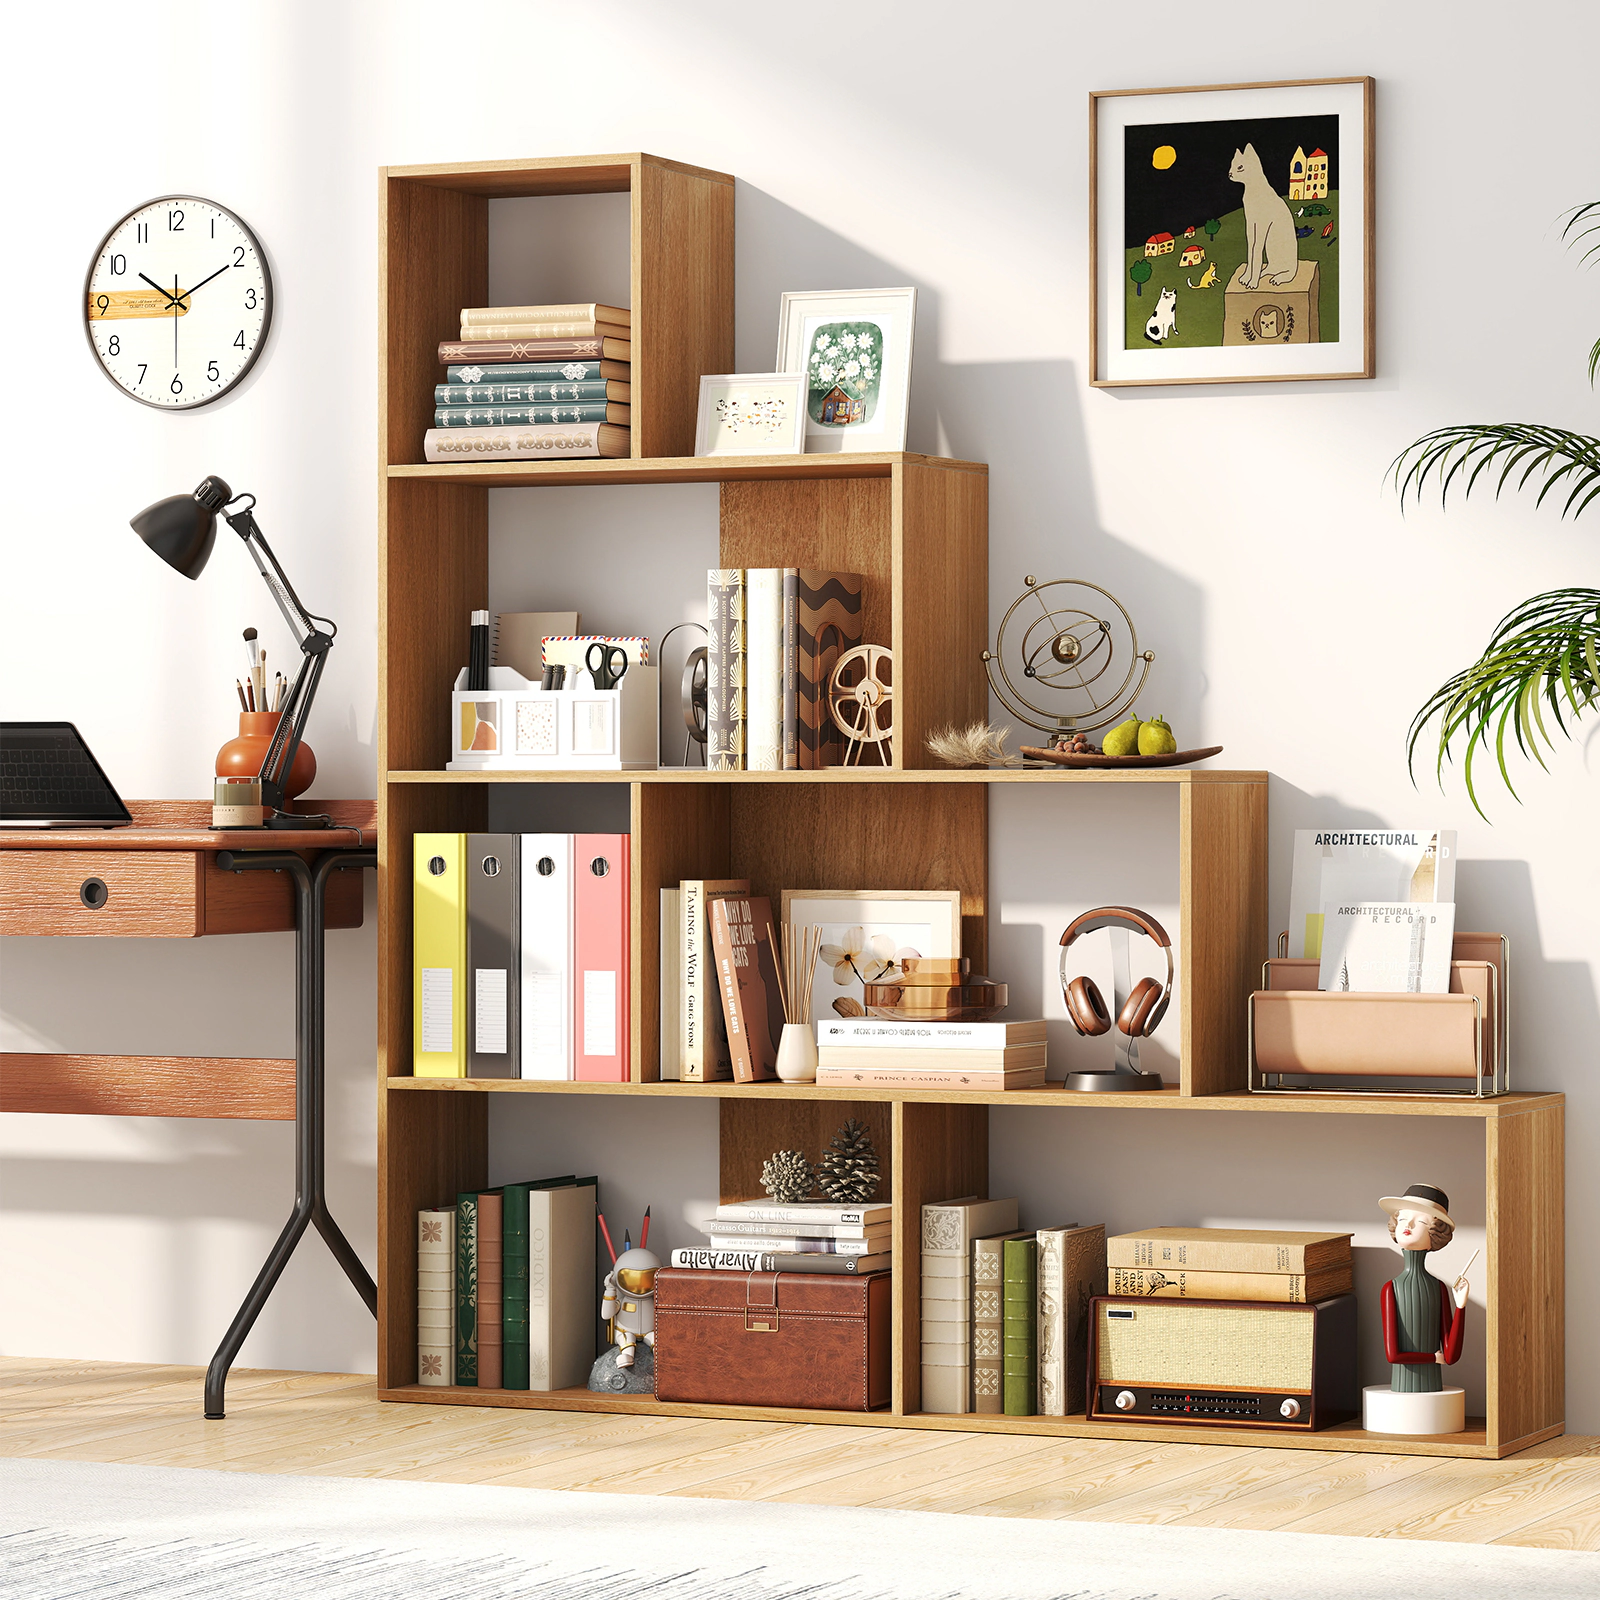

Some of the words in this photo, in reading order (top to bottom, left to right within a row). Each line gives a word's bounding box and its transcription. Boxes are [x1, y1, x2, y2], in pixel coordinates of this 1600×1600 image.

[169, 210, 185, 231] 12
[137, 222, 148, 243] 11
[110, 254, 126, 275] 10
[233, 246, 245, 267] 2
[96, 294, 110, 316] 9
[245, 288, 257, 310] 3
[468, 312, 516, 320] LATINARUM
[515, 311, 545, 319] VOCUM
[108, 335, 120, 356] 8
[233, 329, 246, 350] 4
[137, 363, 148, 384] 7
[206, 360, 220, 382] 5
[170, 373, 183, 394] 6
[1315, 833, 1419, 846] ARCHITECTURAL
[687, 886, 697, 935] TAMING
[723, 900, 742, 924] WHY
[740, 900, 752, 923] DO
[1338, 906, 1414, 916] ARCHITECTURAL
[1372, 915, 1437, 924] RECORD
[687, 938, 695, 952] the
[739, 924, 756, 945] LOVE
[721, 958, 730, 975] WHY
[732, 946, 749, 968] CATS
[687, 953, 697, 988] WOLF
[724, 975, 732, 986] DO
[726, 986, 734, 998] WE
[688, 995, 696, 1020] GREG
[728, 998, 737, 1015] LOVE
[687, 1021, 696, 1049] STONE
[731, 1016, 740, 1034] CATS
[748, 1210, 764, 1220] ON
[768, 1211, 792, 1221] LINE
[841, 1214, 860, 1222] MoMA
[710, 1223, 737, 1232] Picasso
[737, 1224, 767, 1233] Guitars
[533, 1227, 545, 1308] LUXDECO
